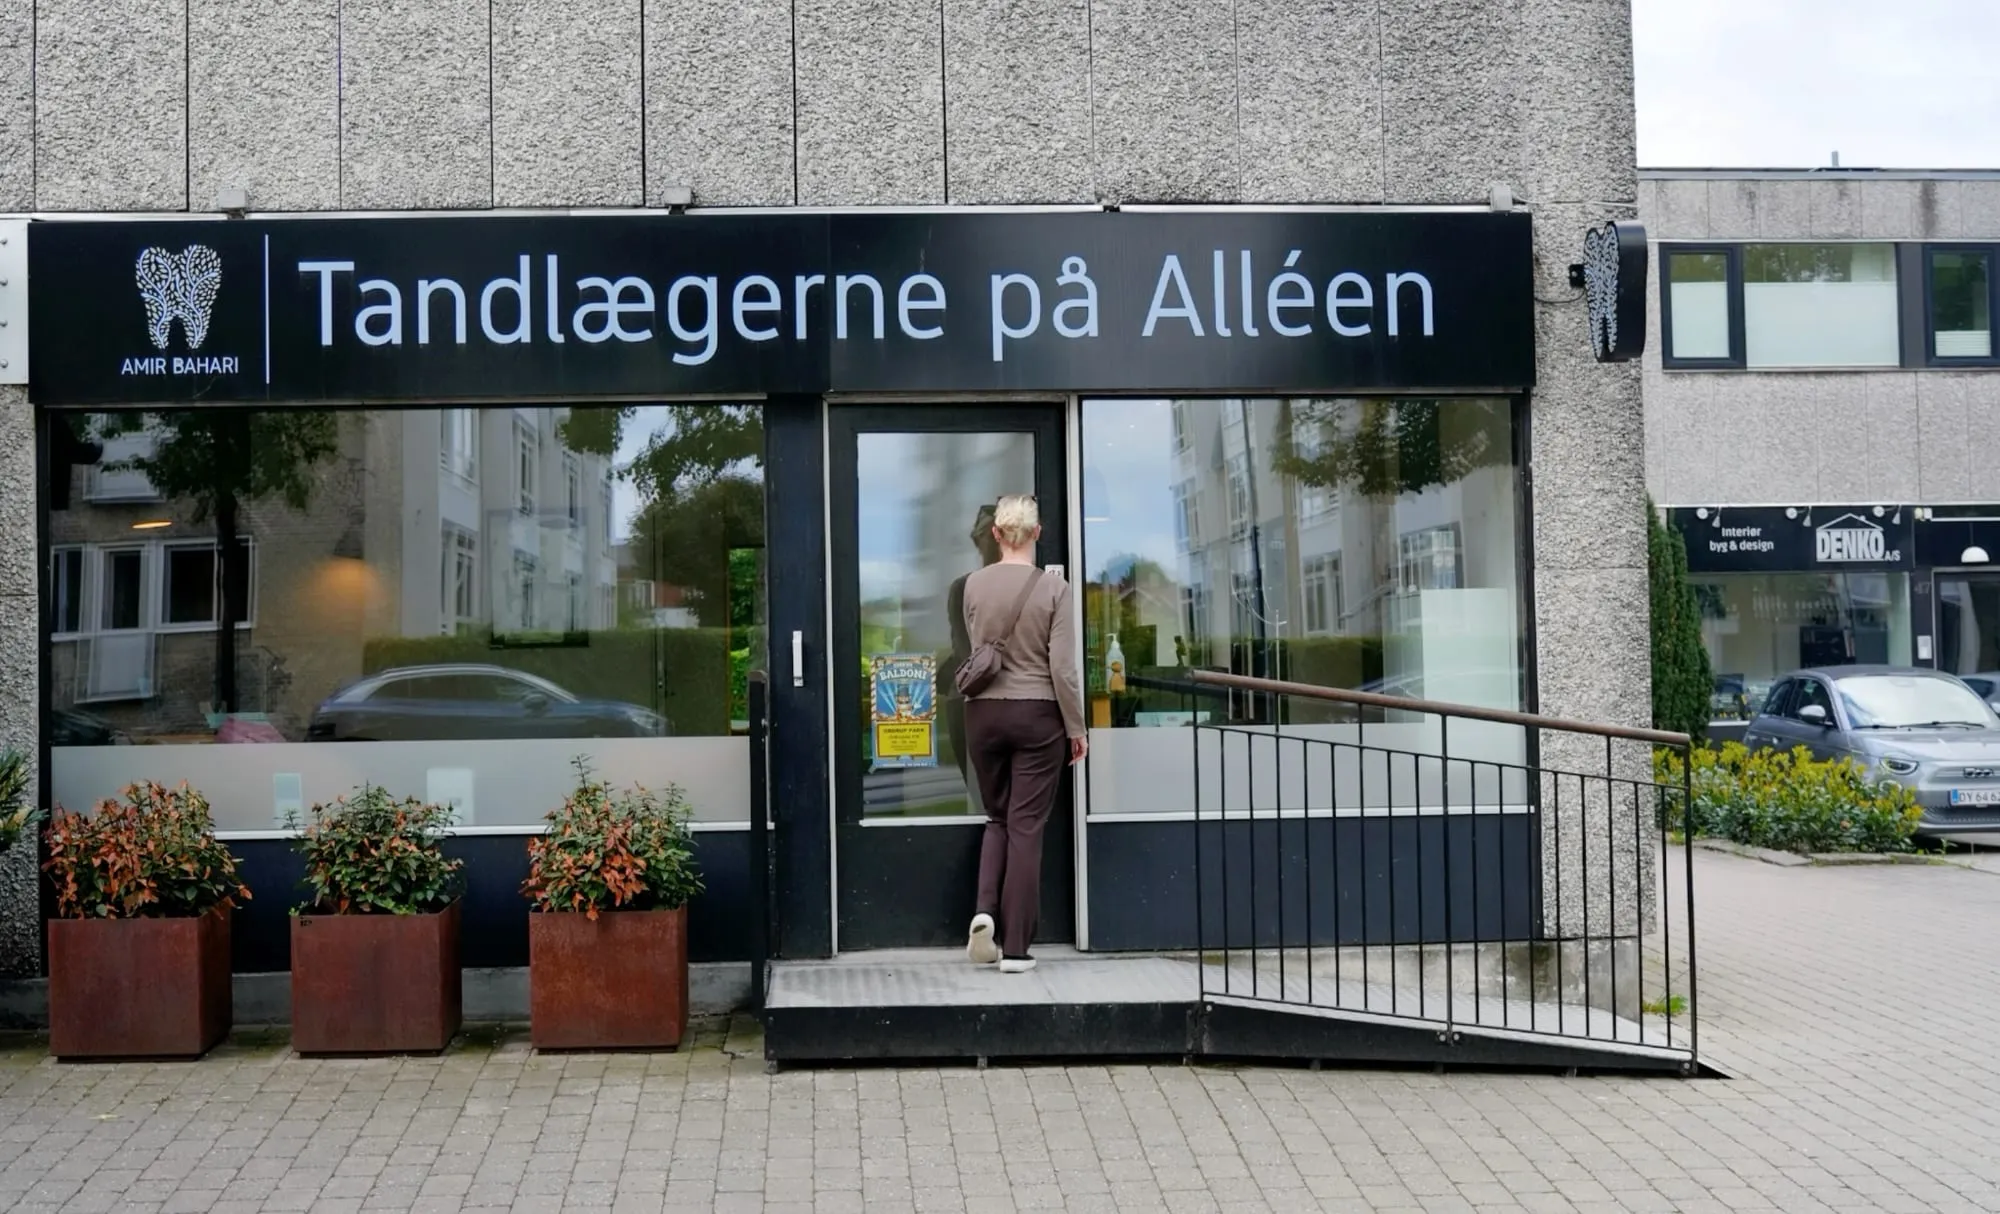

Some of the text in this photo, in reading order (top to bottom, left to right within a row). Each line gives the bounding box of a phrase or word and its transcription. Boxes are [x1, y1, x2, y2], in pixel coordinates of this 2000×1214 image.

[298, 249, 1435, 366] Tandlægerne på Alléen
[121, 356, 239, 375] AMIR BAHARI
[1721, 526, 1762, 537] Interiør
[1709, 540, 1774, 553] byg & design
[1816, 528, 1901, 562] DENKO A/S
[880, 668, 928, 681] BALDONI
